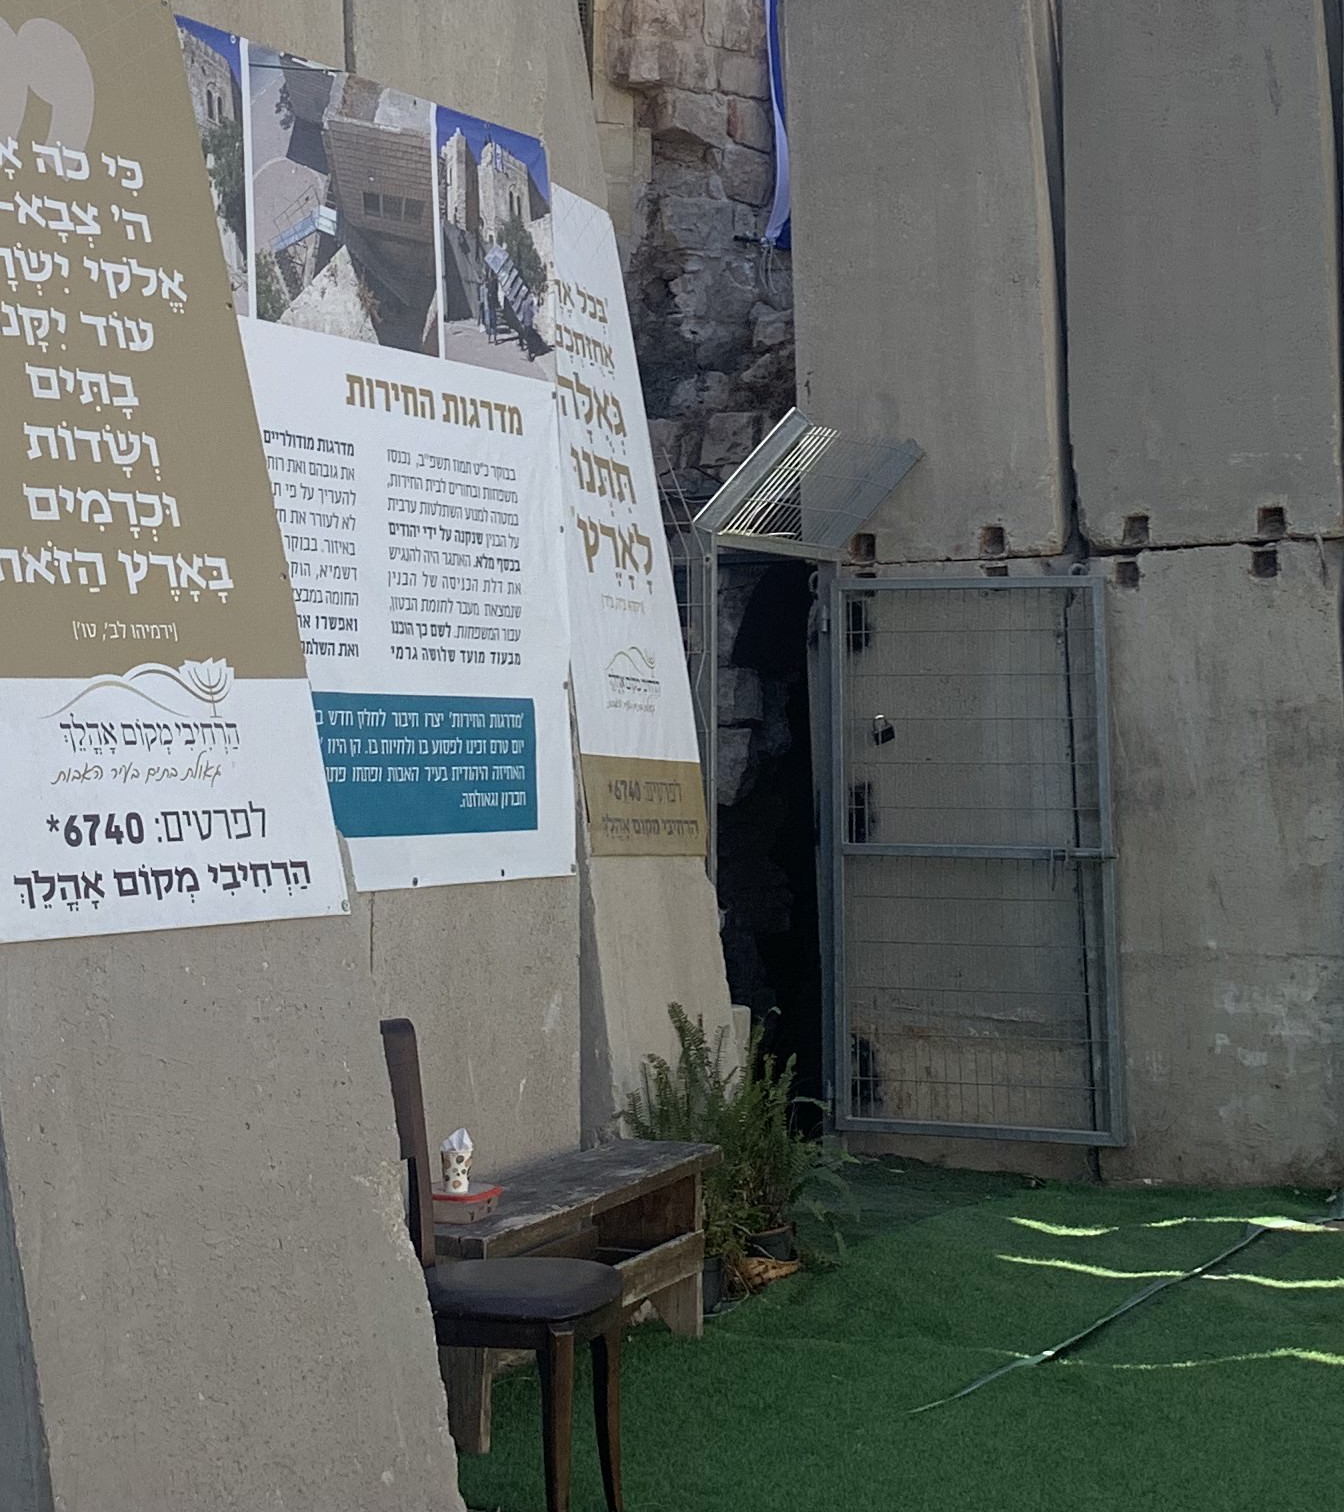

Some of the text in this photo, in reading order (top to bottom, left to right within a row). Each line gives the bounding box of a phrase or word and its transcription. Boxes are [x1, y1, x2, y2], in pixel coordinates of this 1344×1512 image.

[346, 373, 523, 436] מדרגות החירות
[264, 430, 354, 456] מדרגות מודולריים
[285, 483, 356, 506] להעריך על פי
[290, 510, 355, 531] לא לעורר את
[389, 522, 420, 537] יהודים
[423, 526, 436, 539] ידי
[439, 525, 452, 541] על
[455, 529, 483, 546] שנקנה
[389, 546, 420, 562] להנגיש
[424, 550, 439, 564] היה
[497, 558, 520, 573] בכסף
[388, 571, 521, 594] את דלת הכניסה של הבנין
[391, 646, 521, 665] מבעוד מועד שלושה גרמי
[328, 711, 353, 725] חדש
[357, 708, 386, 729] לחלק
[392, 712, 419, 727] חיבור
[424, 713, 444, 727] יצרו
[155, 801, 266, 843] לפרטים:
